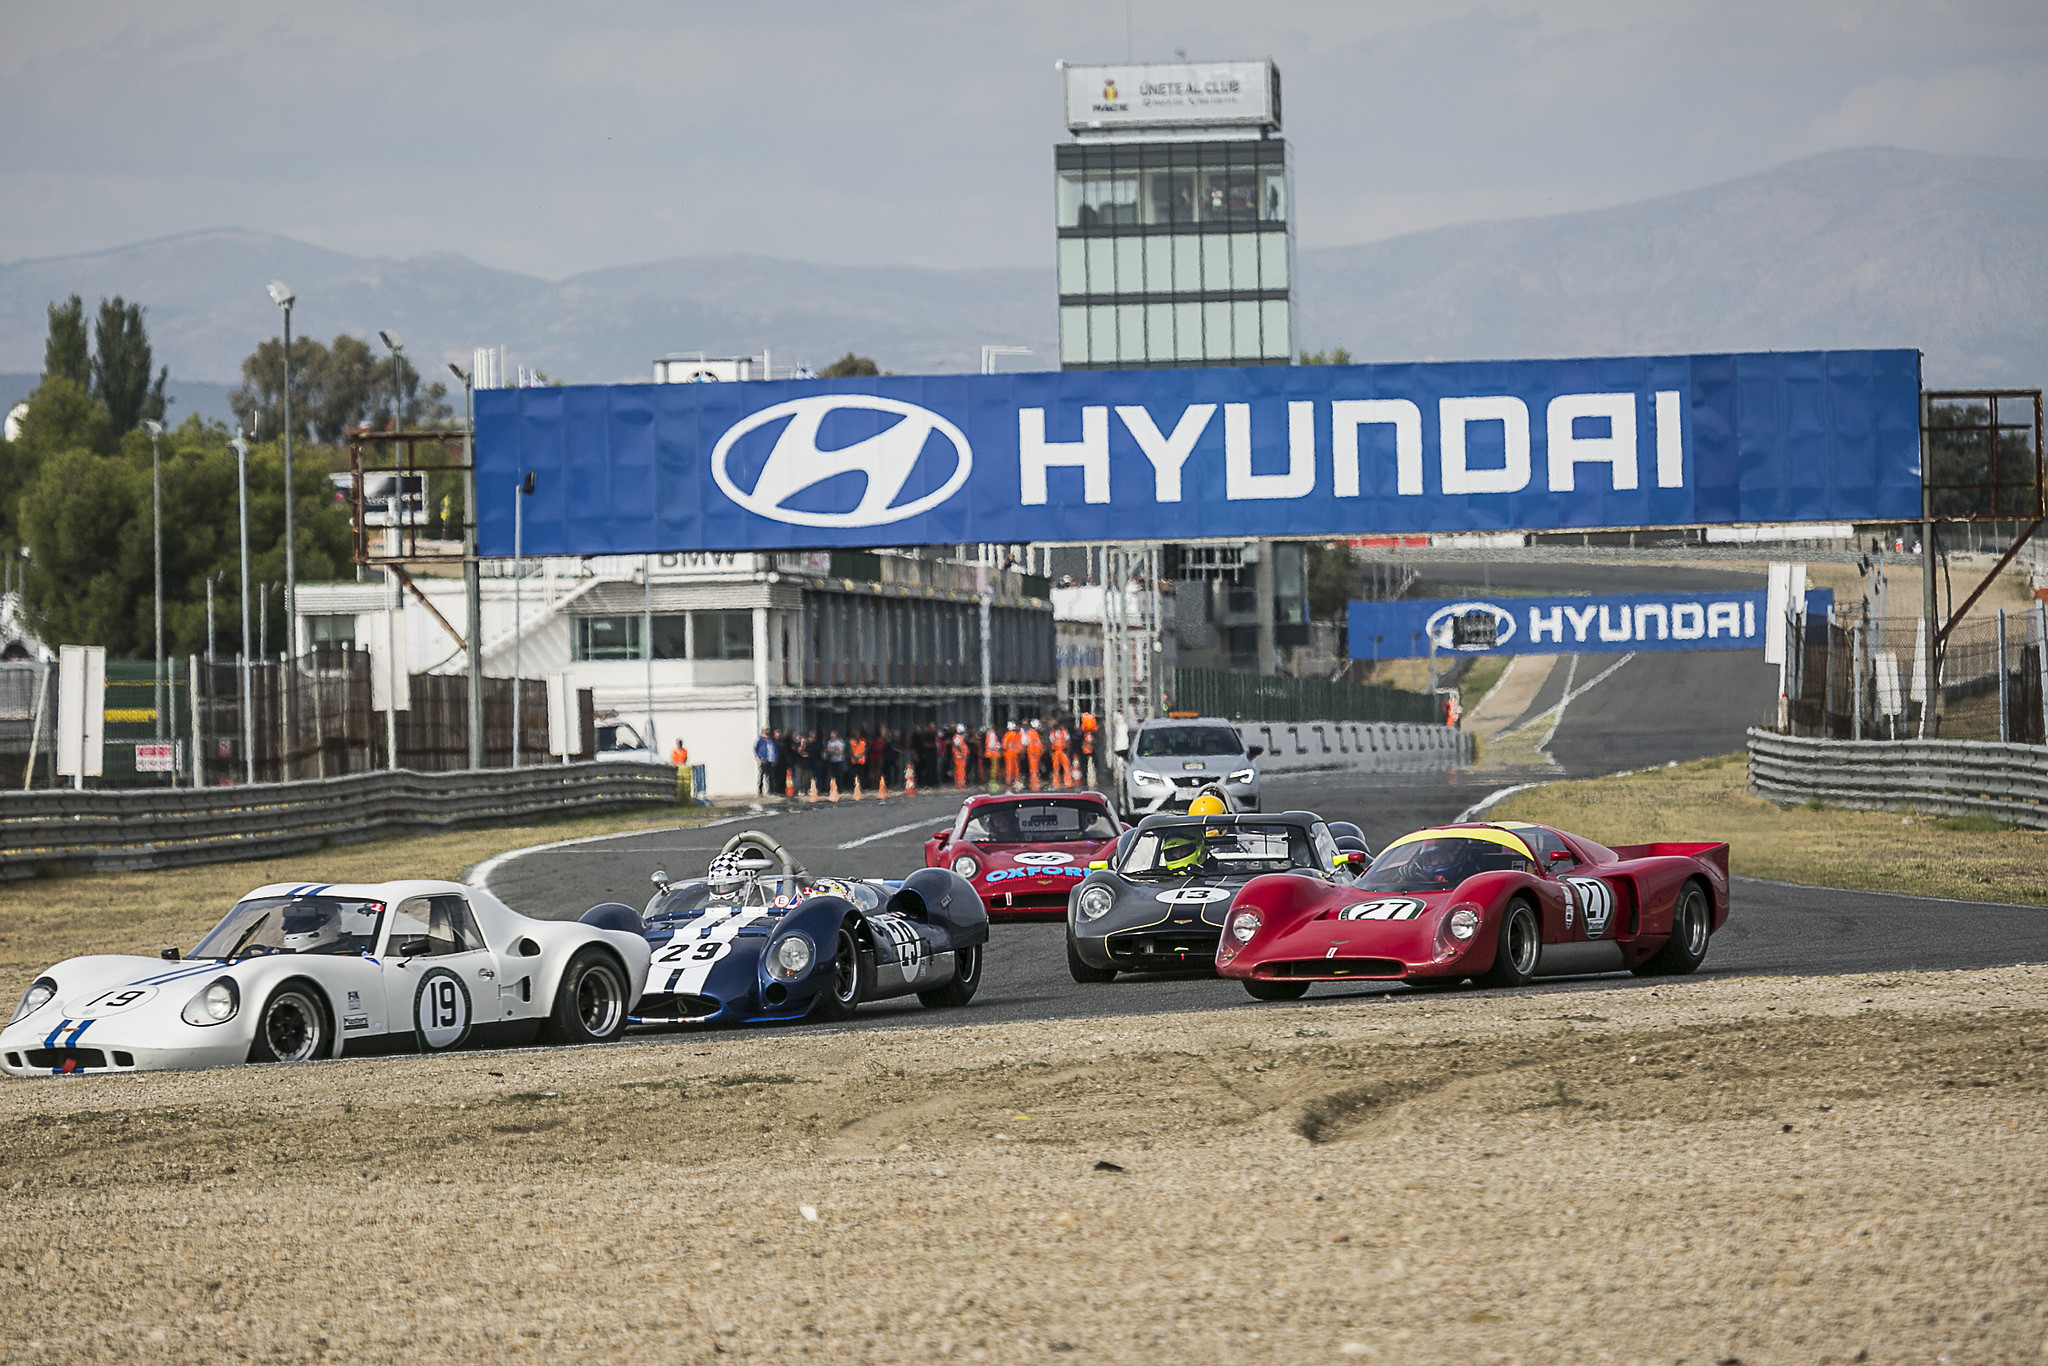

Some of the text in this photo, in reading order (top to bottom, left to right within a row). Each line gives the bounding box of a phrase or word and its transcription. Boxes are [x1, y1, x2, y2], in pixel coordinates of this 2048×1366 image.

[1204, 80, 1240, 94] CLUB
[1019, 391, 1684, 506] HYUNDAI
[660, 553, 735, 568] BMW
[1529, 601, 1755, 643] HYUNDAI
[1175, 890, 1210, 899] 13
[1575, 881, 1605, 919] 27
[1355, 902, 1411, 921] 27
[658, 942, 723, 963] 29
[85, 991, 146, 1007] 19
[430, 981, 457, 1028] 19
